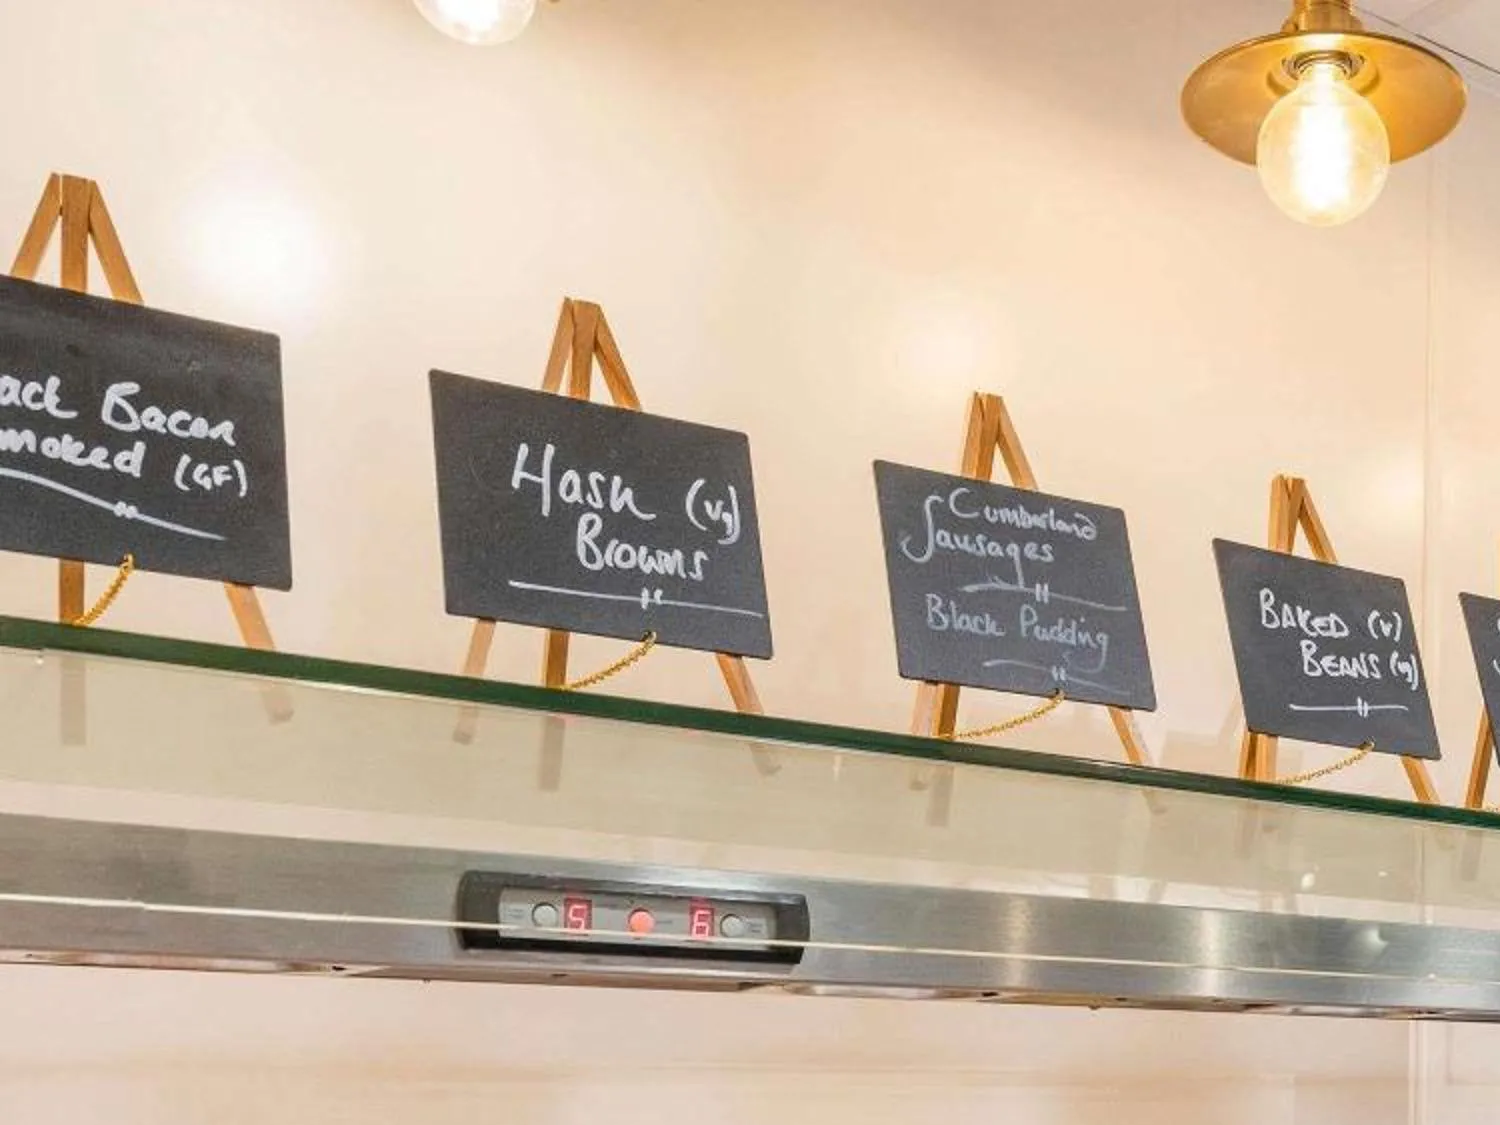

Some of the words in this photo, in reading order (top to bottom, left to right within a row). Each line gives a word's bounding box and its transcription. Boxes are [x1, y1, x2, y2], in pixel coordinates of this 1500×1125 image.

[0, 375, 79, 419] ack
[102, 382, 237, 446] Bacon
[0, 428, 147, 478] moked
[174, 453, 248, 497] (GF)
[511, 443, 656, 520] Hash
[576, 512, 709, 581] Browns
[900, 495, 1055, 588] Sausages
[950, 488, 1098, 541] Cumberland
[925, 593, 1006, 637] Black
[1019, 604, 1110, 673] Pudding
[1259, 587, 1350, 638] BAKED
[1300, 639, 1382, 679] BEANS
[692, 909, 712, 938] 6
